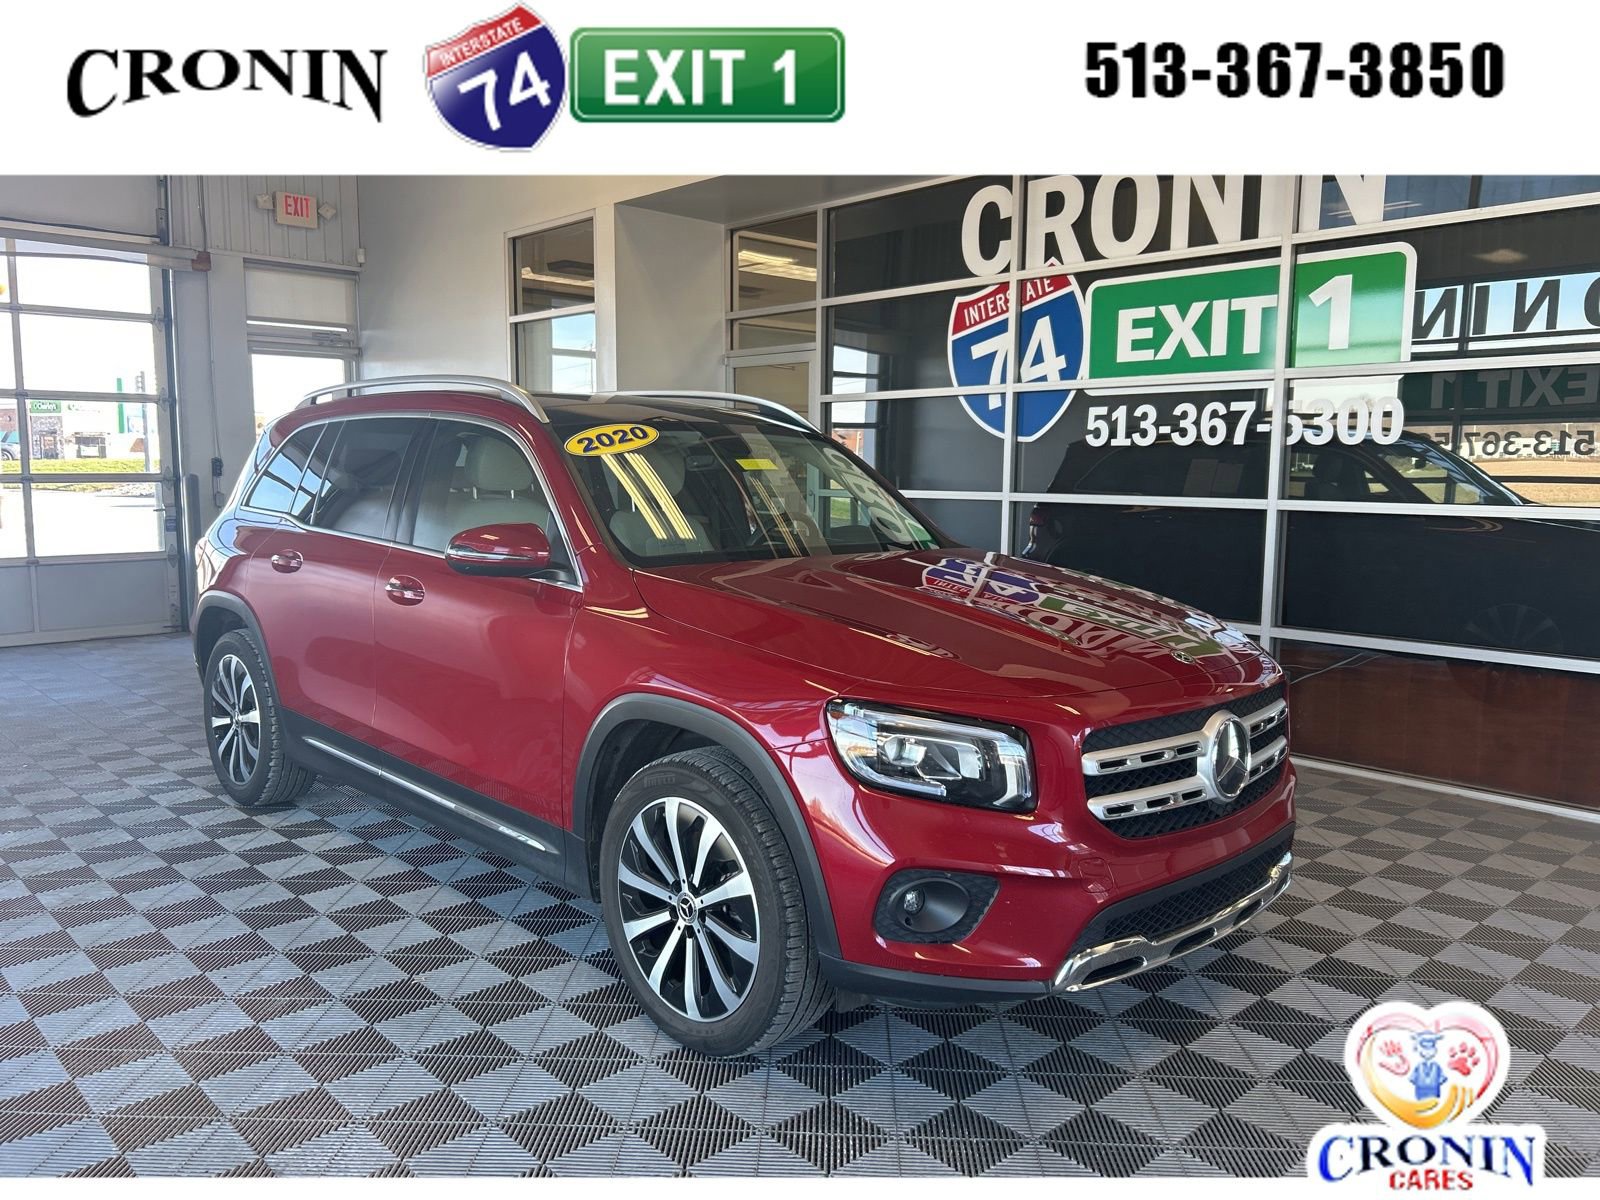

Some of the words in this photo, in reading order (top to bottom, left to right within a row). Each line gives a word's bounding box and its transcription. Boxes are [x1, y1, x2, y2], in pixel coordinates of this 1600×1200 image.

[284, 194, 310, 218] EXIT
[961, 174, 1387, 278] CRONIN
[963, 278, 1055, 327] INTERSATE
[1116, 294, 1279, 364] EXIT
[1308, 274, 1353, 350] 1
[970, 315, 1067, 411] 74
[576, 426, 649, 453] 2020
[1085, 396, 1404, 447] 513-367-5300
